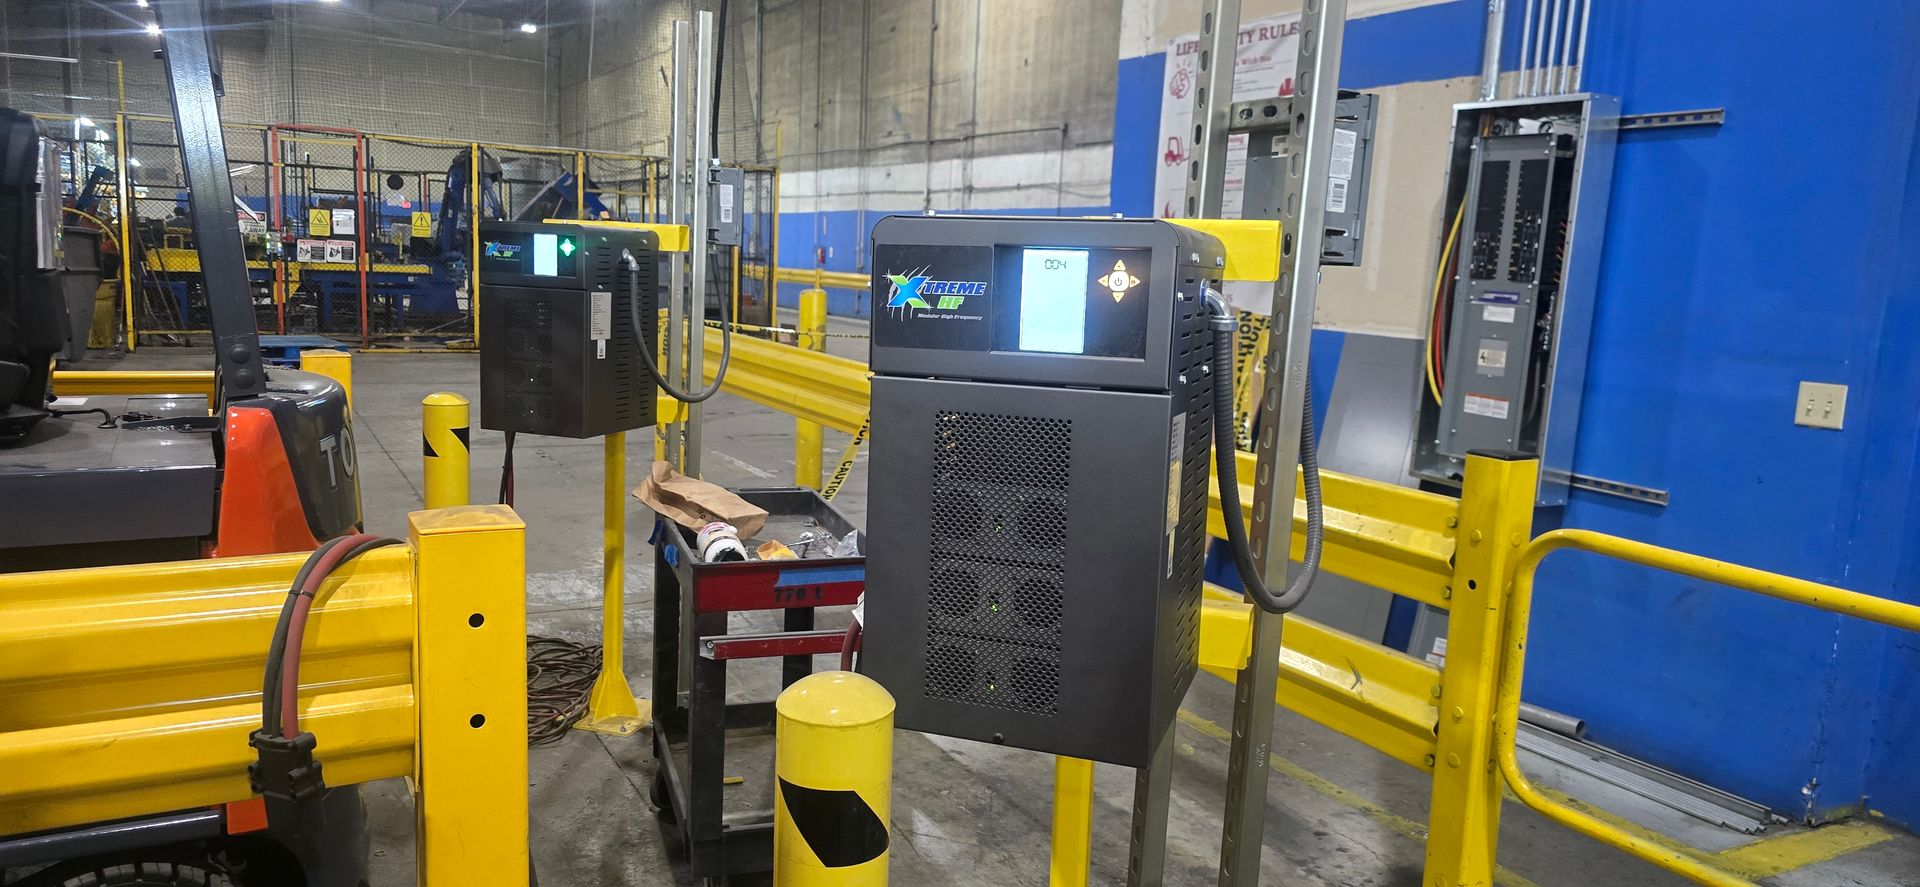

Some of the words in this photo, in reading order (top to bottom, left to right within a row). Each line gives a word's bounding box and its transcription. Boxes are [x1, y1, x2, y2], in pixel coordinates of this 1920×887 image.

[1259, 21, 1300, 42] RULE
[1045, 259, 1067, 270] 004
[887, 275, 987, 309] XTREME
[937, 296, 965, 310] HF
[822, 460, 853, 500] CAUTION
